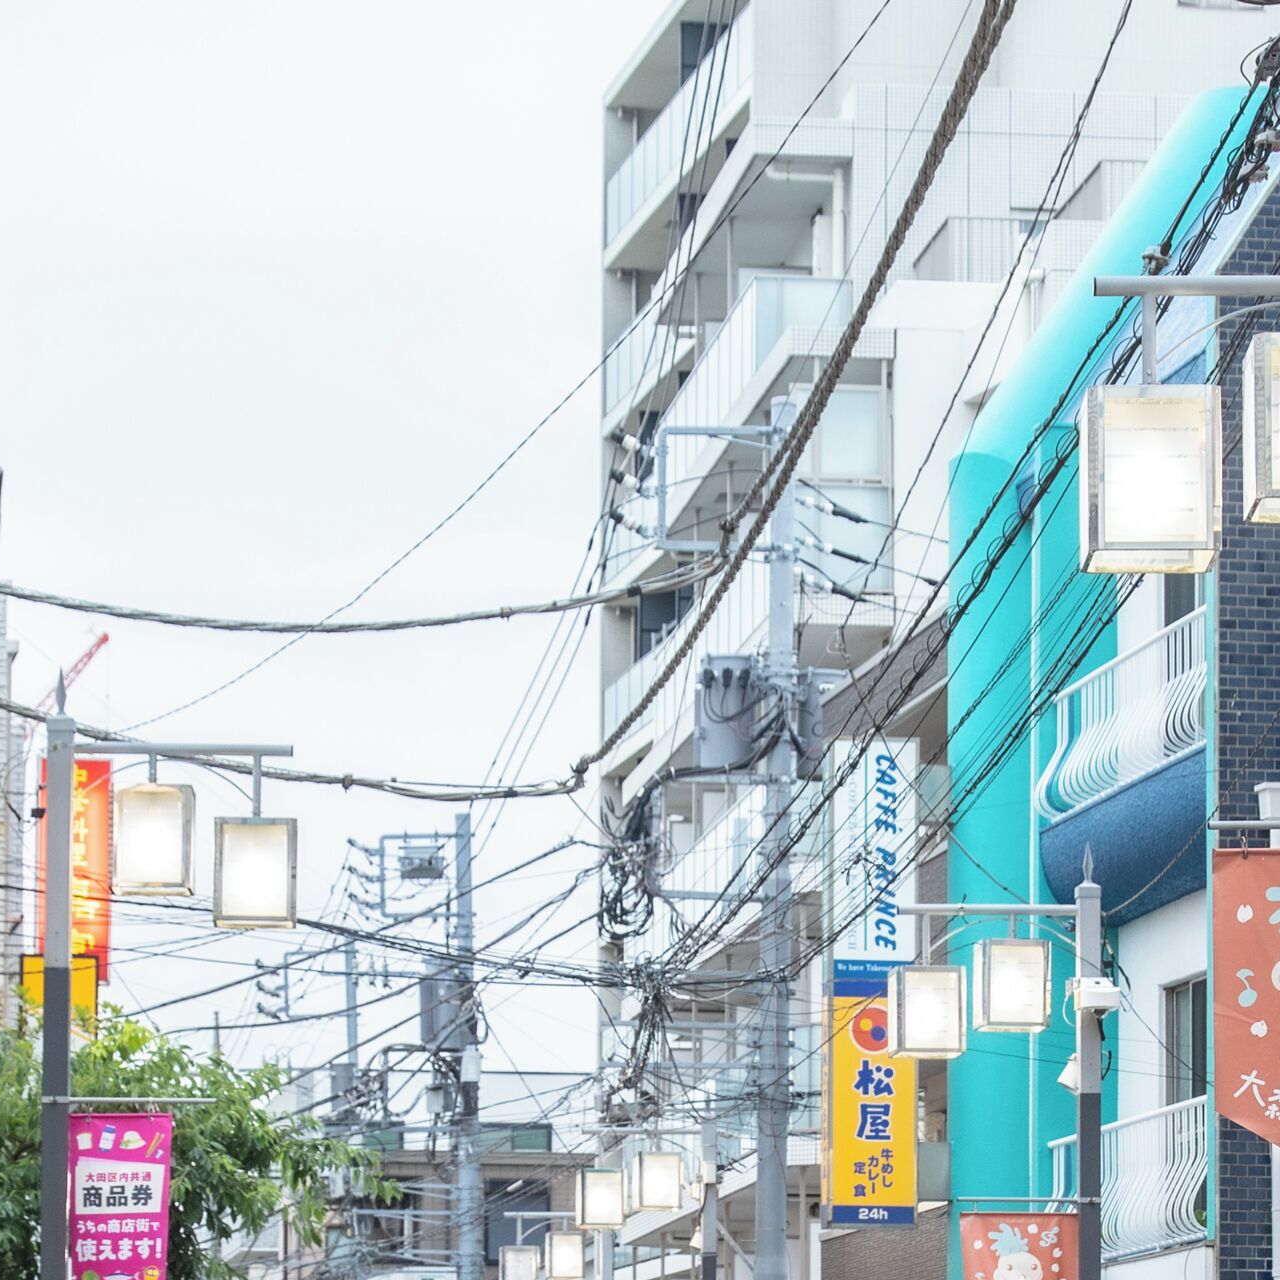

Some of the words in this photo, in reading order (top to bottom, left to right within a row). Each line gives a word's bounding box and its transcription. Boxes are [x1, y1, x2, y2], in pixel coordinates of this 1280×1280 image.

[875, 847, 897, 951] PRINCE
[837, 962, 846, 972] We
[848, 962, 864, 972] have
[853, 1059, 894, 1141] 松屋
[86, 1171, 152, 1183] 大田区内共通
[854, 1161, 866, 1197] 定食
[868, 1155, 879, 1194] カレー
[881, 1148, 893, 1188] 牛めし
[82, 1184, 153, 1208] 商品券
[77, 1219, 160, 1233] うちの商店街で
[858, 1208, 888, 1220] 24h
[75, 1238, 162, 1262] 使えます!
